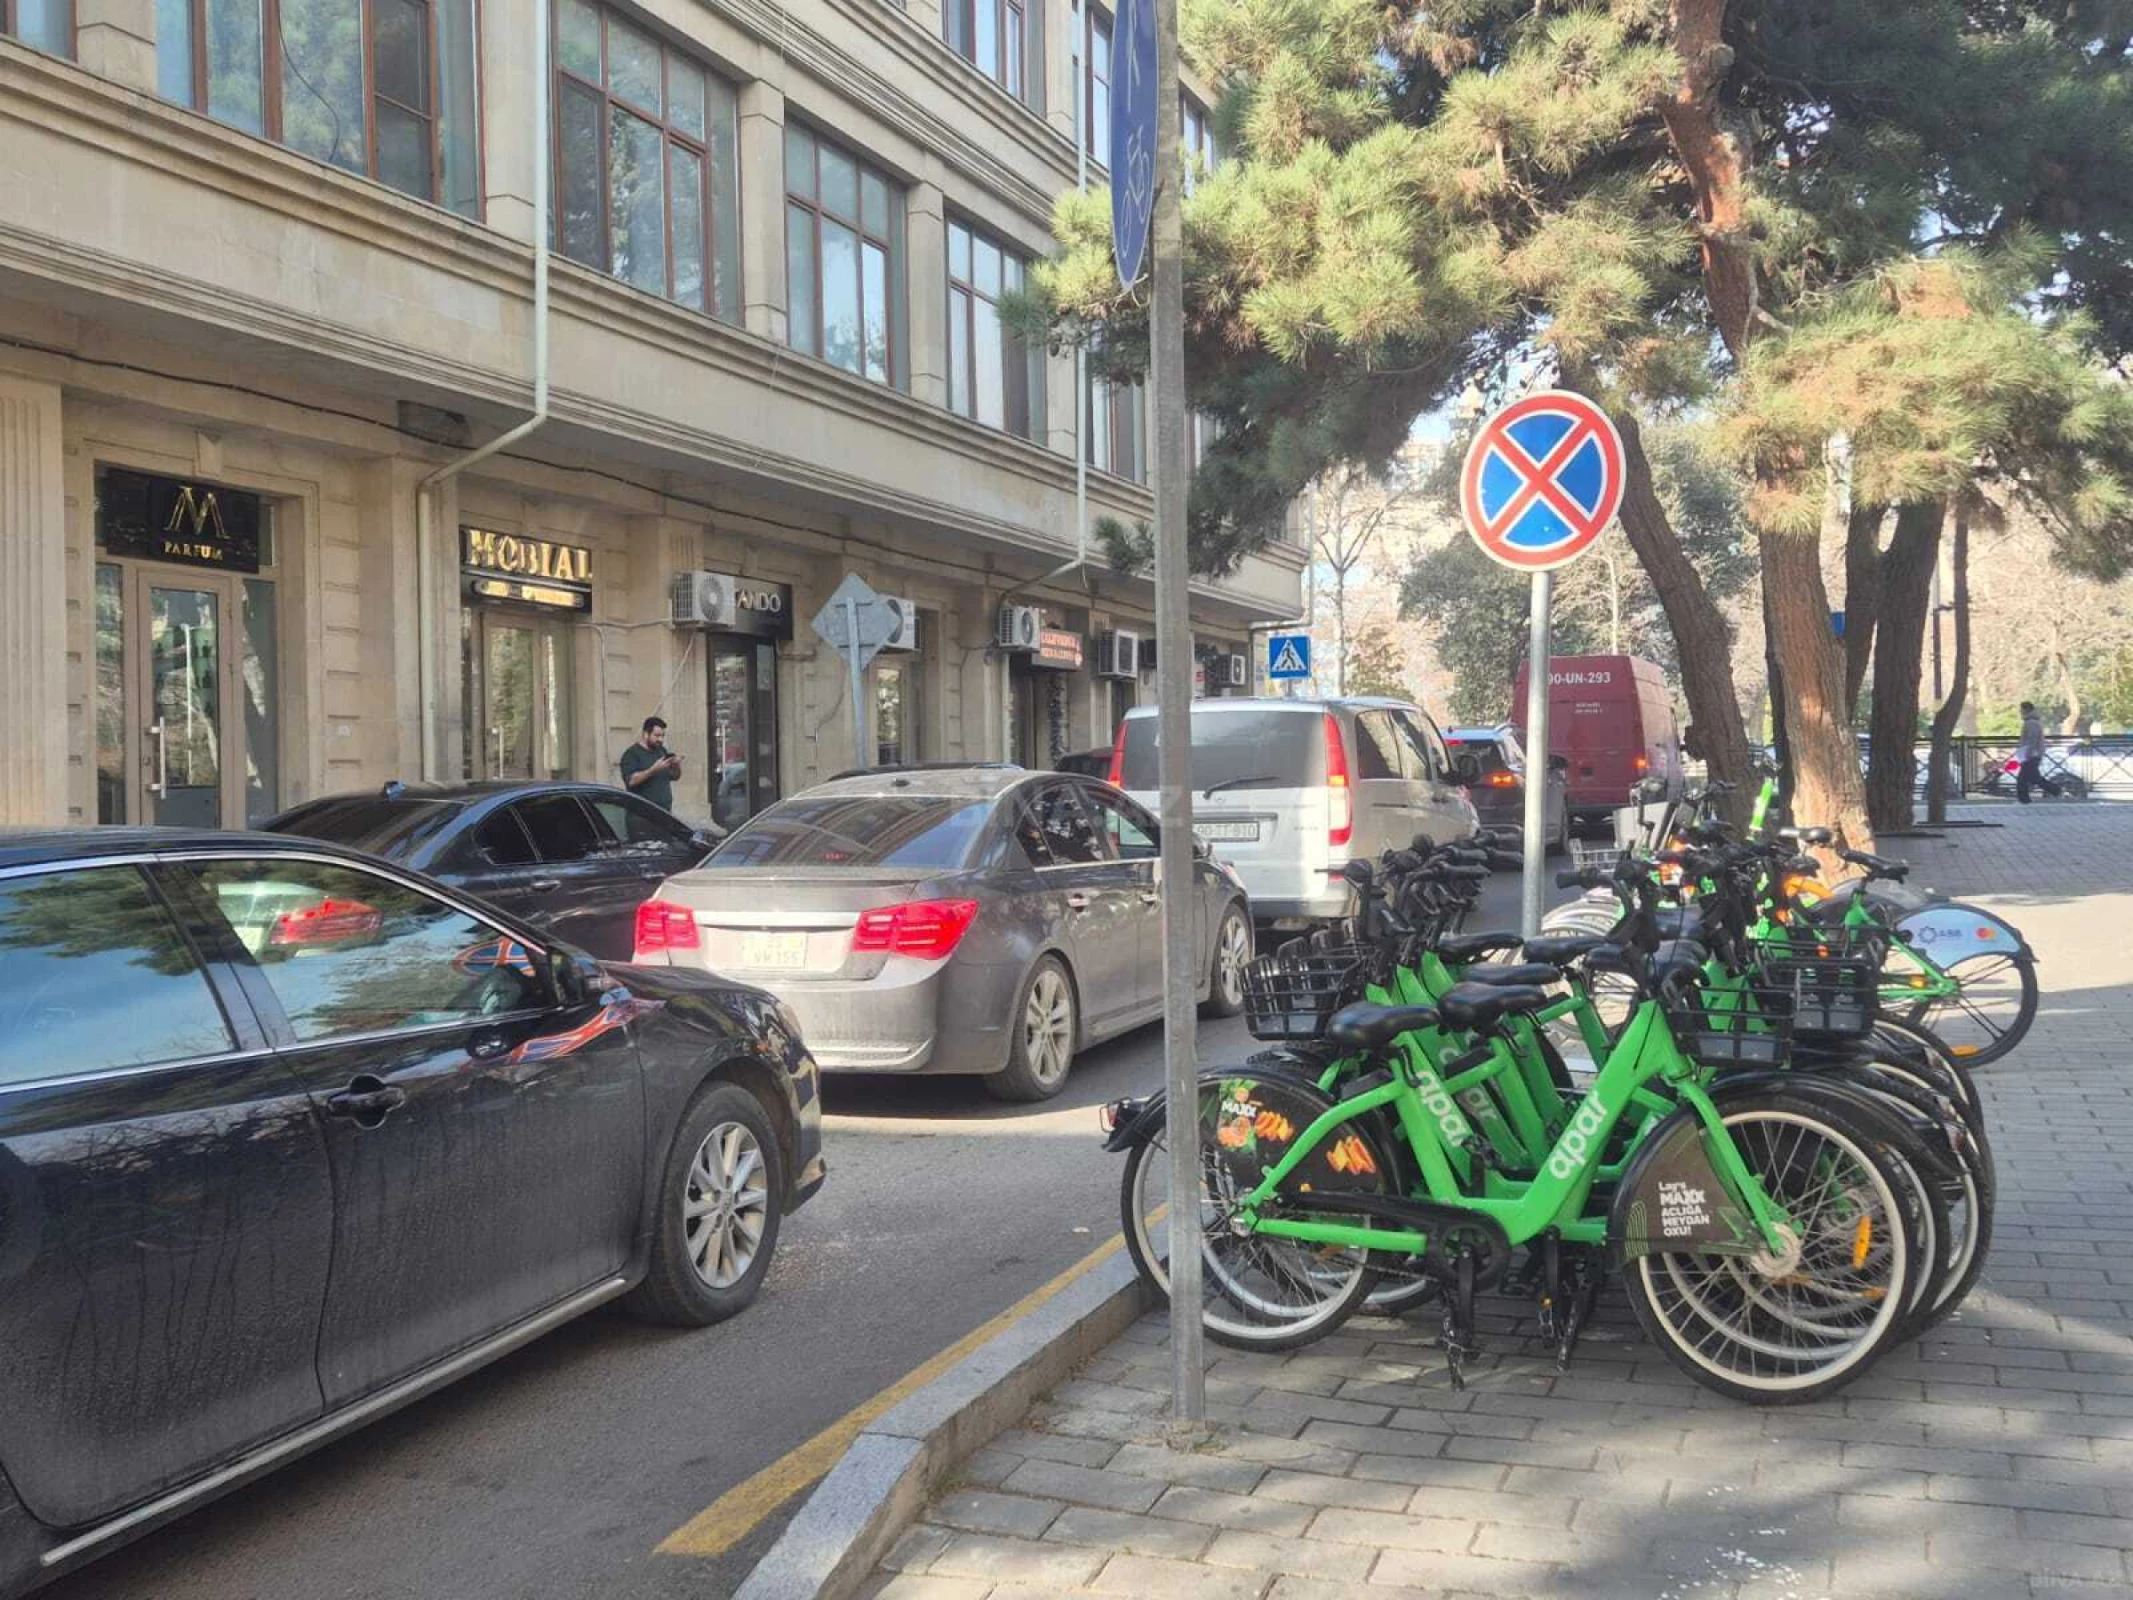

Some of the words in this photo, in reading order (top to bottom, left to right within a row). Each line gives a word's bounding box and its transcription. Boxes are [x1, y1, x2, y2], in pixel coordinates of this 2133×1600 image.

[164, 541, 224, 560] PARFUM
[1548, 1090, 1608, 1180] apar
[1660, 1189, 1706, 1206] MAXX
[1662, 1214, 1710, 1227] MEYDAN
